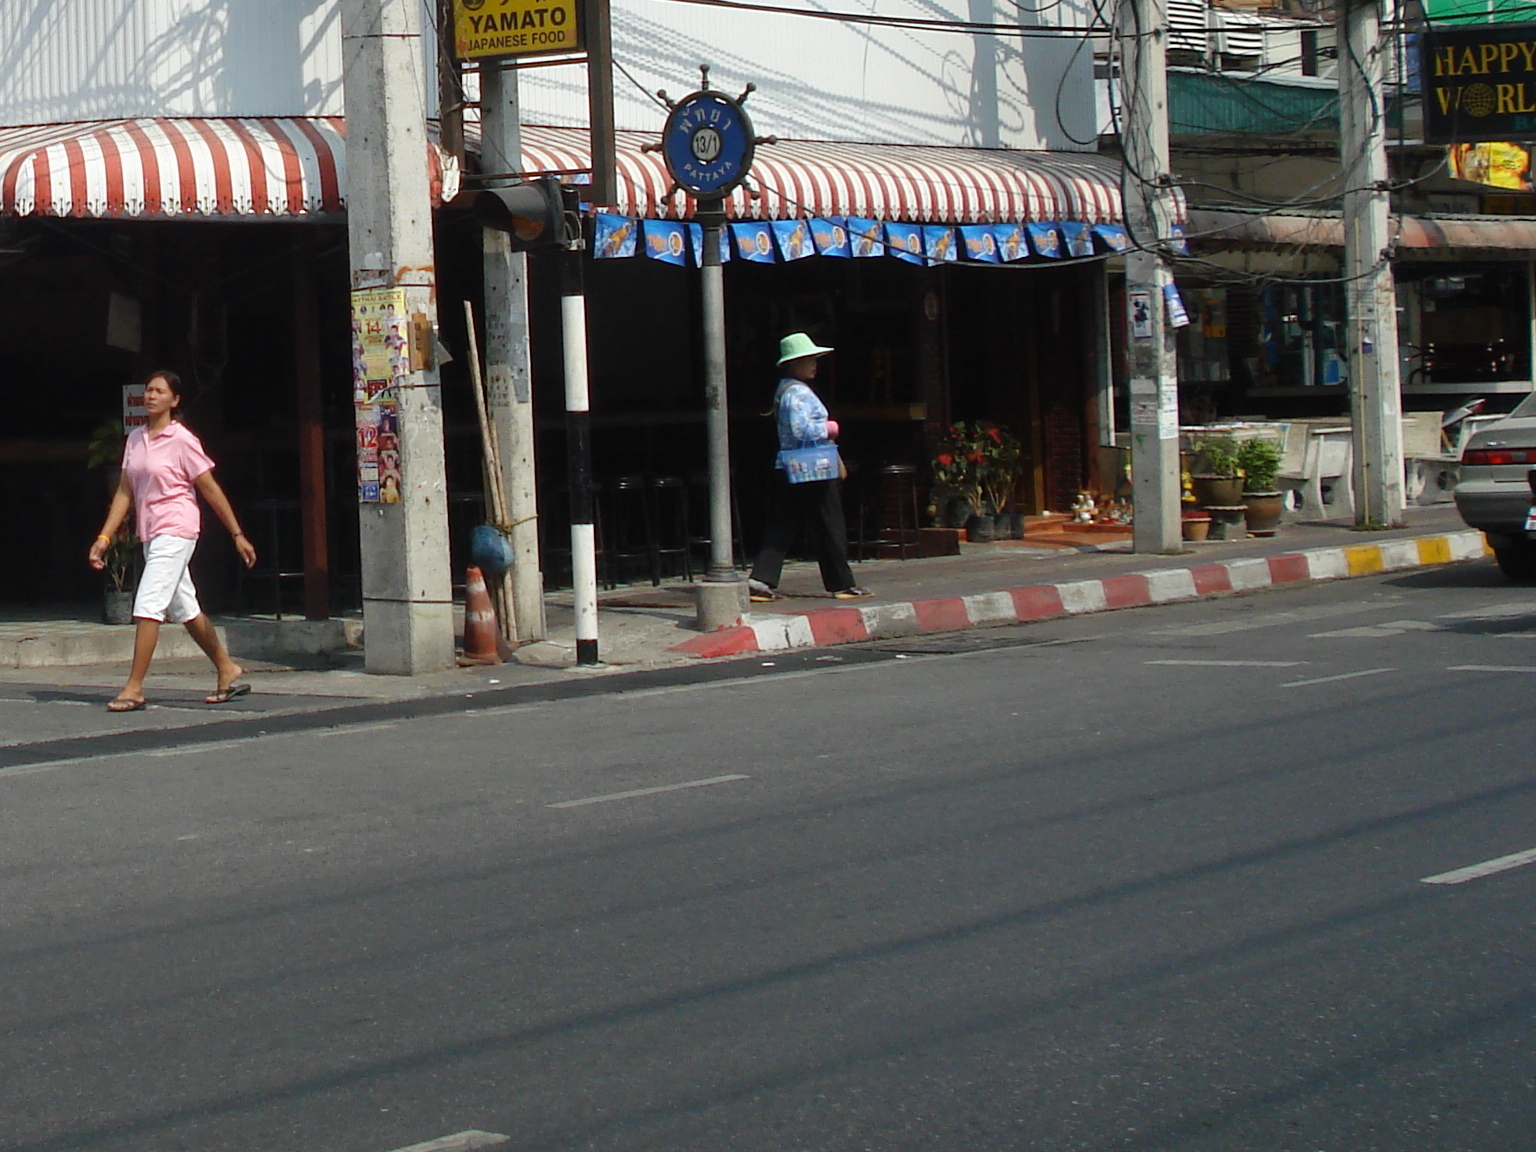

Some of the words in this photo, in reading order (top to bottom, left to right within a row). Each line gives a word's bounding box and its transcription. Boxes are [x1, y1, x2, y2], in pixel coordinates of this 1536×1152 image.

[469, 7, 566, 34] YAMATO
[469, 34, 527, 51] JAPANESE
[532, 31, 565, 45] FOOD
[1433, 42, 1536, 76] HAPPY
[695, 134, 718, 154] 13/1
[684, 161, 732, 181] PATTAYA
[365, 321, 381, 334] 14
[357, 427, 378, 448] 12
